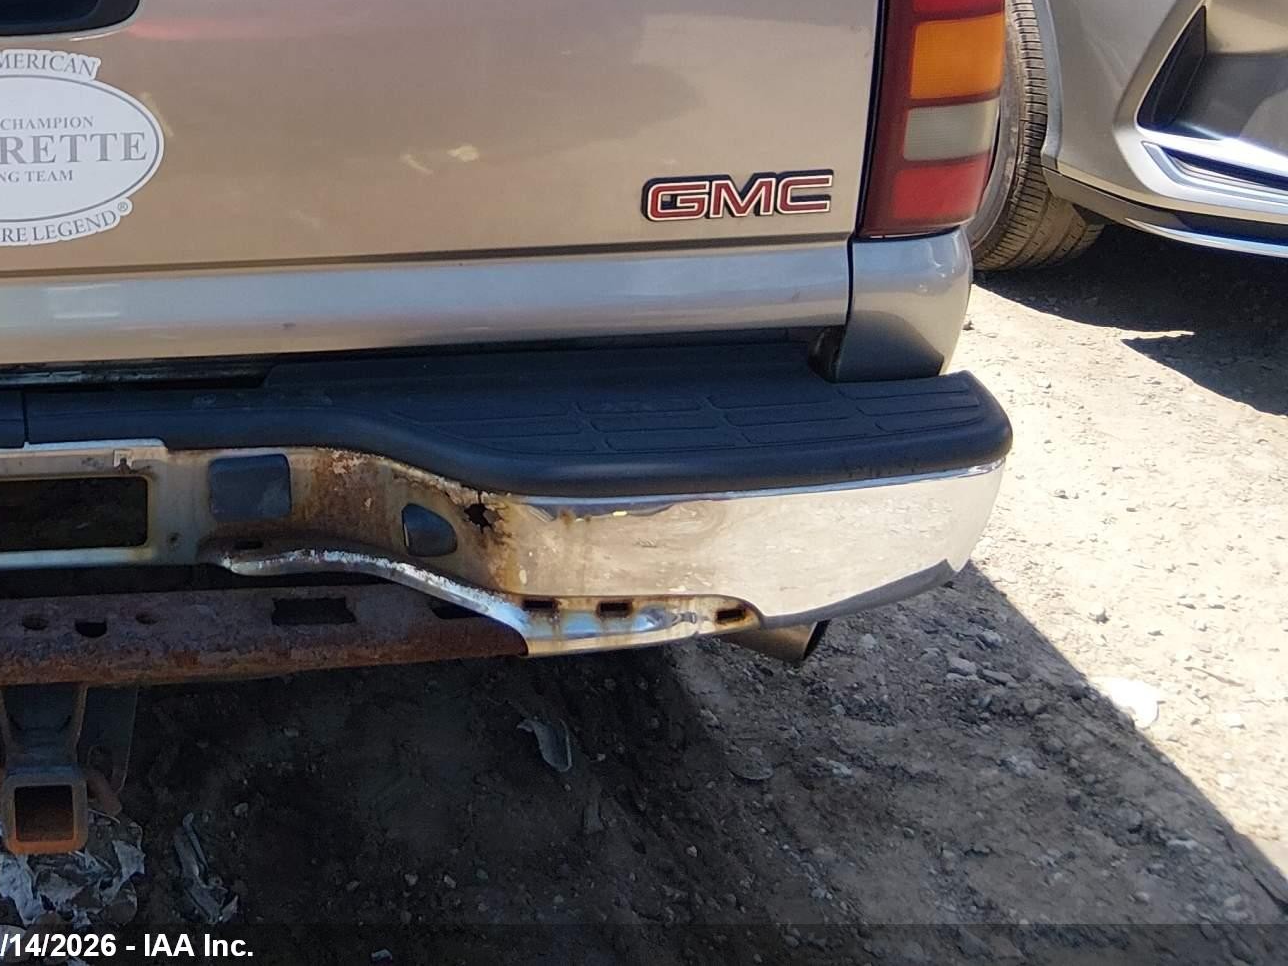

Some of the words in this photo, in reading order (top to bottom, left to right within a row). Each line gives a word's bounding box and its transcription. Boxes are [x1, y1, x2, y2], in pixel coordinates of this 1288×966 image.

[0, 116, 94, 131] CHAMPION
[24, 169, 74, 183] TEAM
[641, 169, 834, 222] GMC
